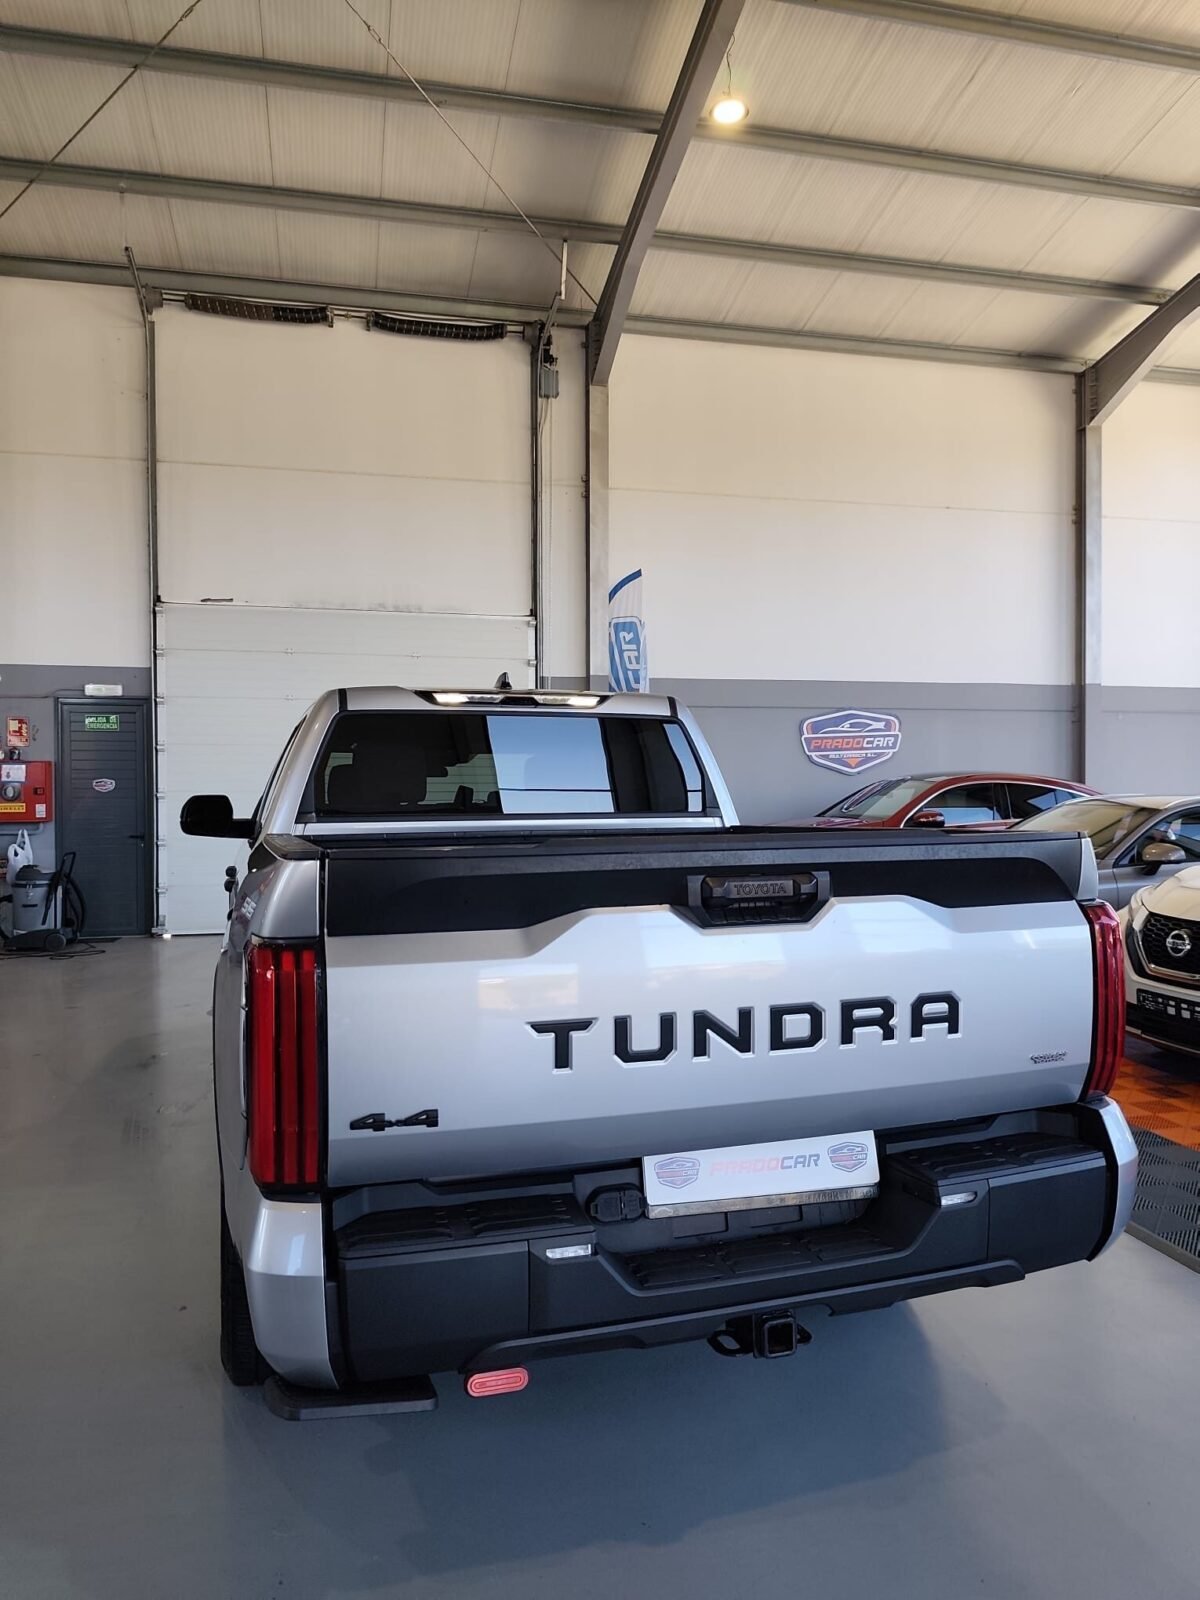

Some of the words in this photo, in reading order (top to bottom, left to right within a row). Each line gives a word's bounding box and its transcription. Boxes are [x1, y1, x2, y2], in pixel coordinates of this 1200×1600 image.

[810, 736, 895, 749] PRADOCAR
[734, 883, 787, 896] TOYOTA
[525, 991, 963, 1074] TUNDRA
[710, 1153, 820, 1176] PRADOCAR
